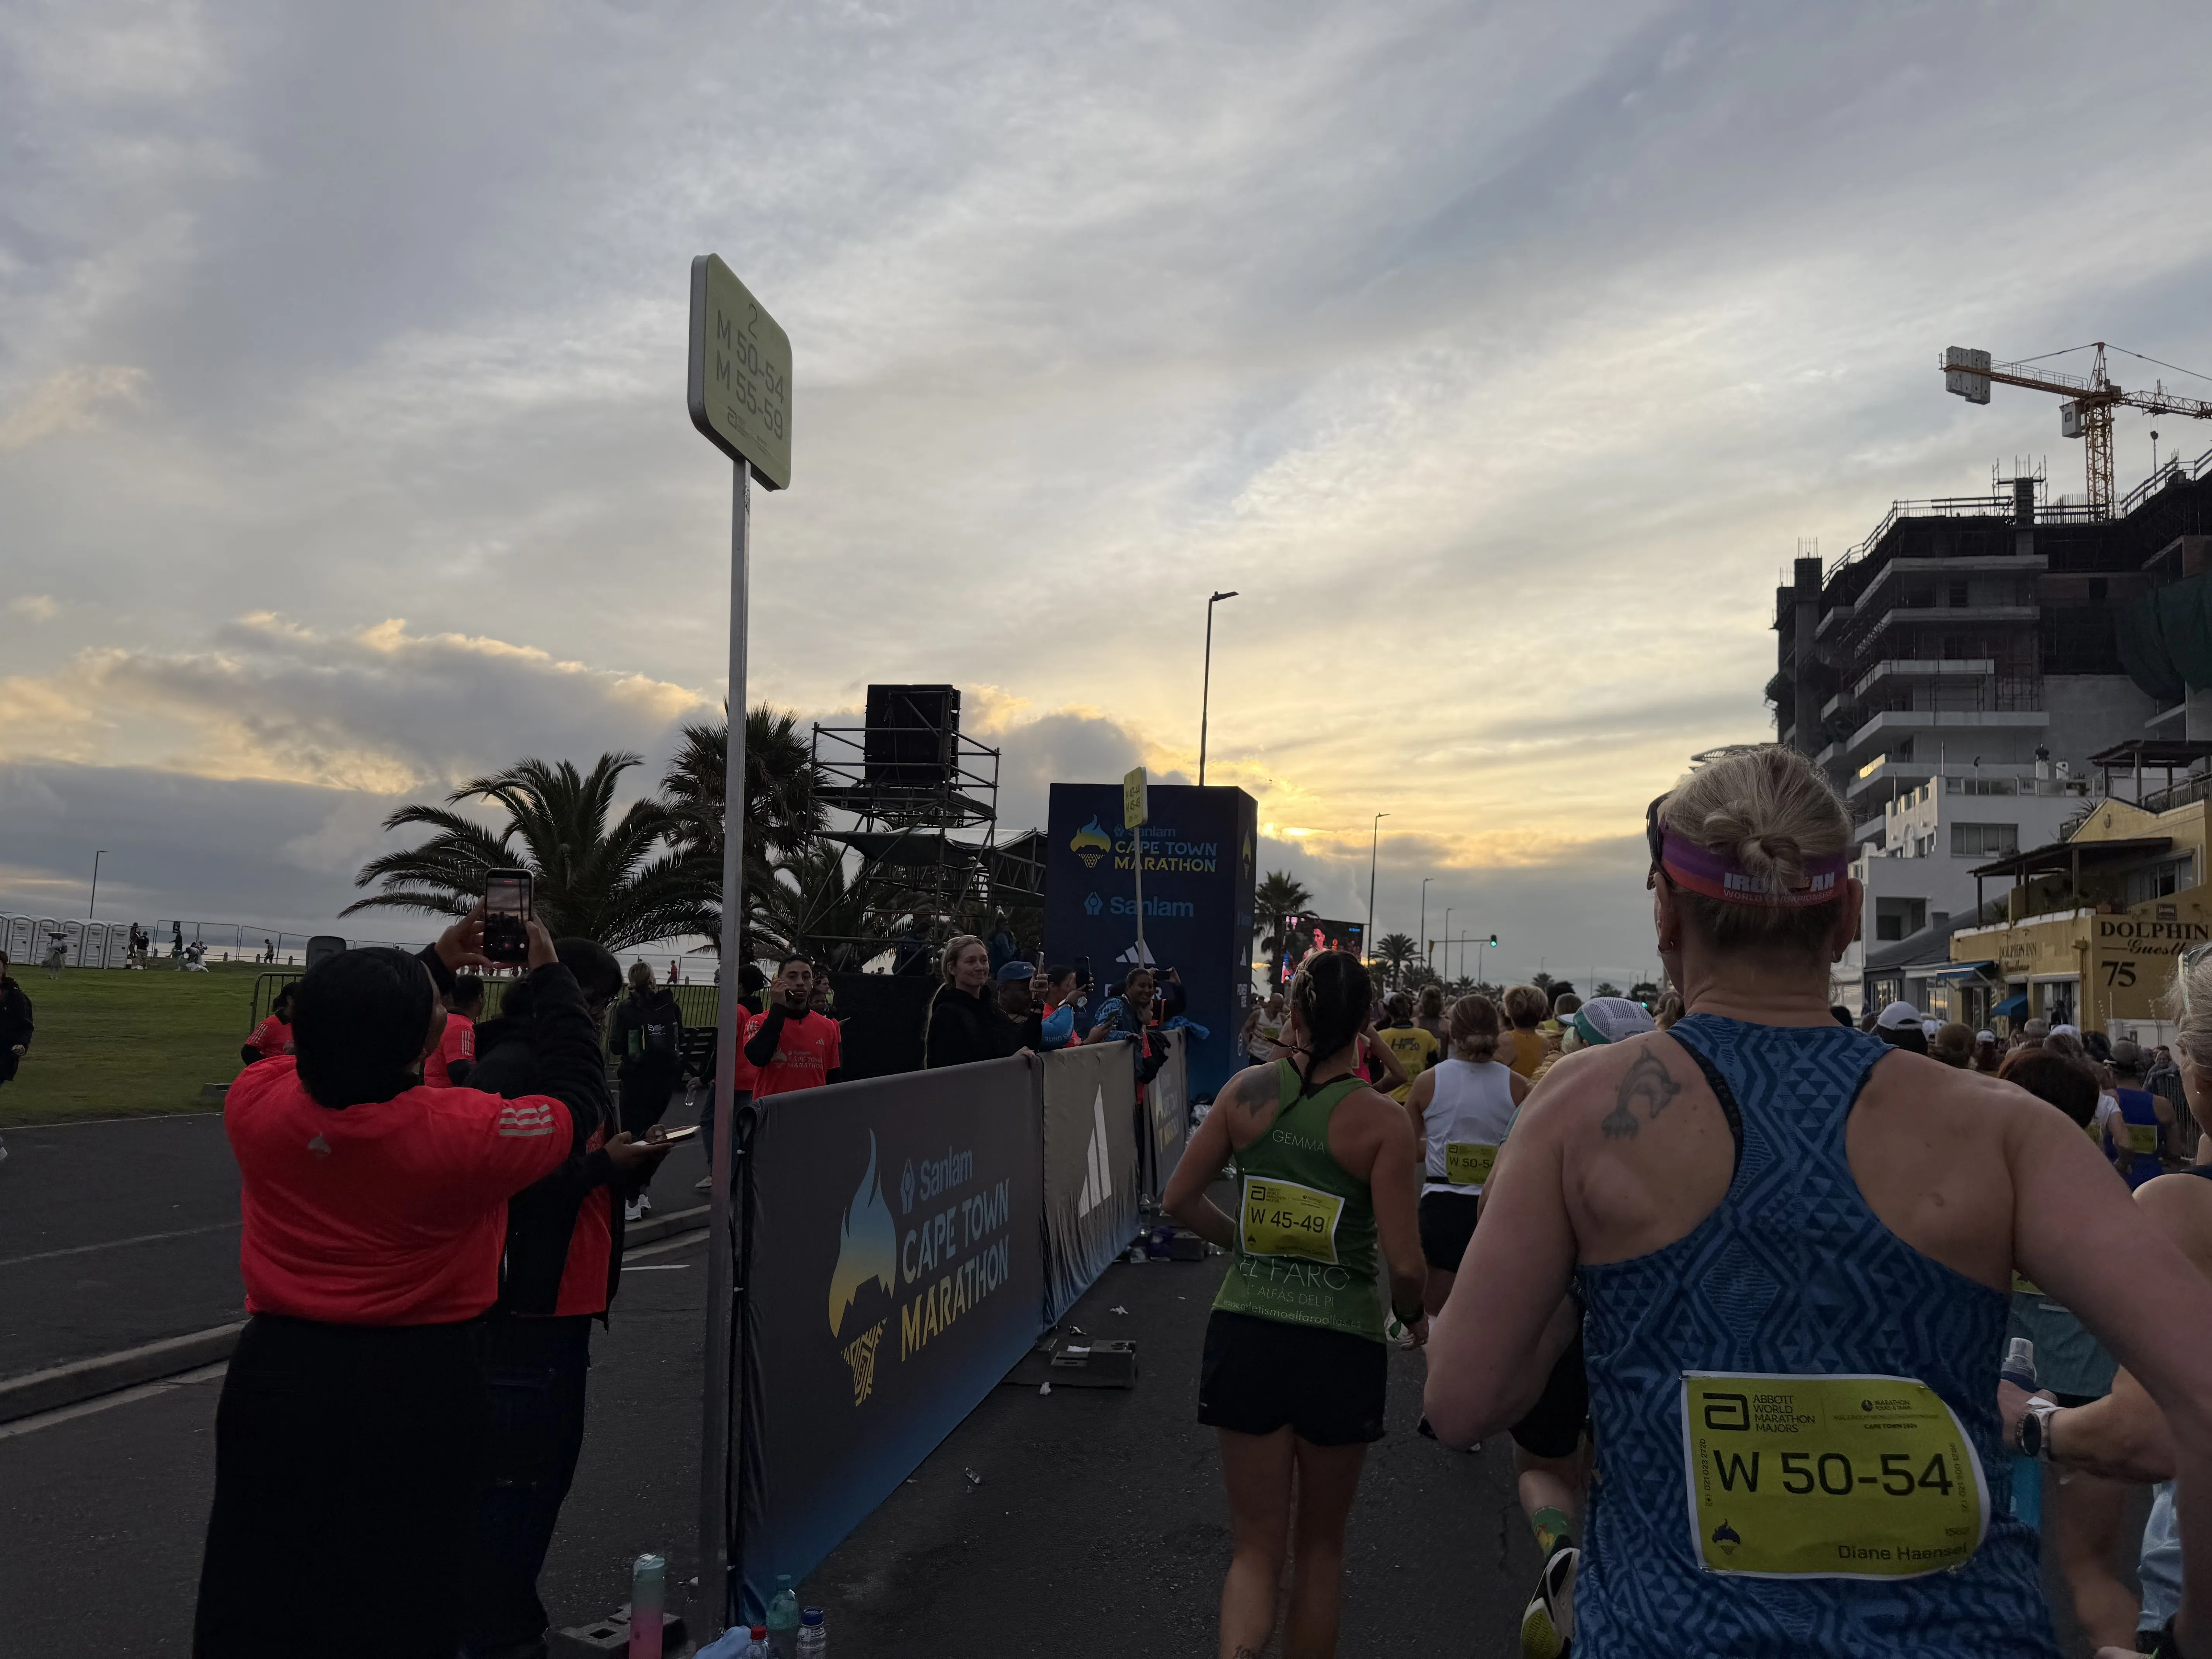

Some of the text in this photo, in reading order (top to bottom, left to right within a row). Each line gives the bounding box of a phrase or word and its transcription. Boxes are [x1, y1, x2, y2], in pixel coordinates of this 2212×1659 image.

[749, 302, 757, 340] 2
[717, 309, 731, 349] M
[737, 329, 785, 405] 50-54
[716, 349, 783, 441] M 55-59
[1115, 840, 1218, 857] CAPE TOWN
[1114, 856, 1217, 872] MARATHON
[1724, 890, 1762, 902] WORLD
[1110, 896, 1194, 917] Sanlam
[2100, 921, 2209, 940] DOLPHIN
[1999, 941, 2036, 958] DOLPHIN INN
[2101, 960, 2136, 987] 75
[1272, 1130, 1325, 1155] GEMMA
[1449, 1156, 1458, 1166] W
[919, 1145, 974, 1202] Sanlam
[1251, 1207, 1266, 1224] W
[1270, 1211, 1325, 1233] 45-49
[902, 1178, 1010, 1284] CAPE TOWN
[1239, 1254, 1258, 1278] EL
[901, 1234, 1010, 1363] MARATHON
[1299, 1293, 1321, 1307] DEL
[1324, 1296, 1334, 1307] PI
[1753, 1395, 1794, 1404] ABBOTT
[1753, 1404, 1793, 1414] WORLD
[1754, 1414, 1816, 1424] MARATHON
[1756, 1423, 1799, 1432] MAJORS
[1712, 1449, 1954, 1497] W 50-54
[1838, 1545, 1891, 1560] Diane
